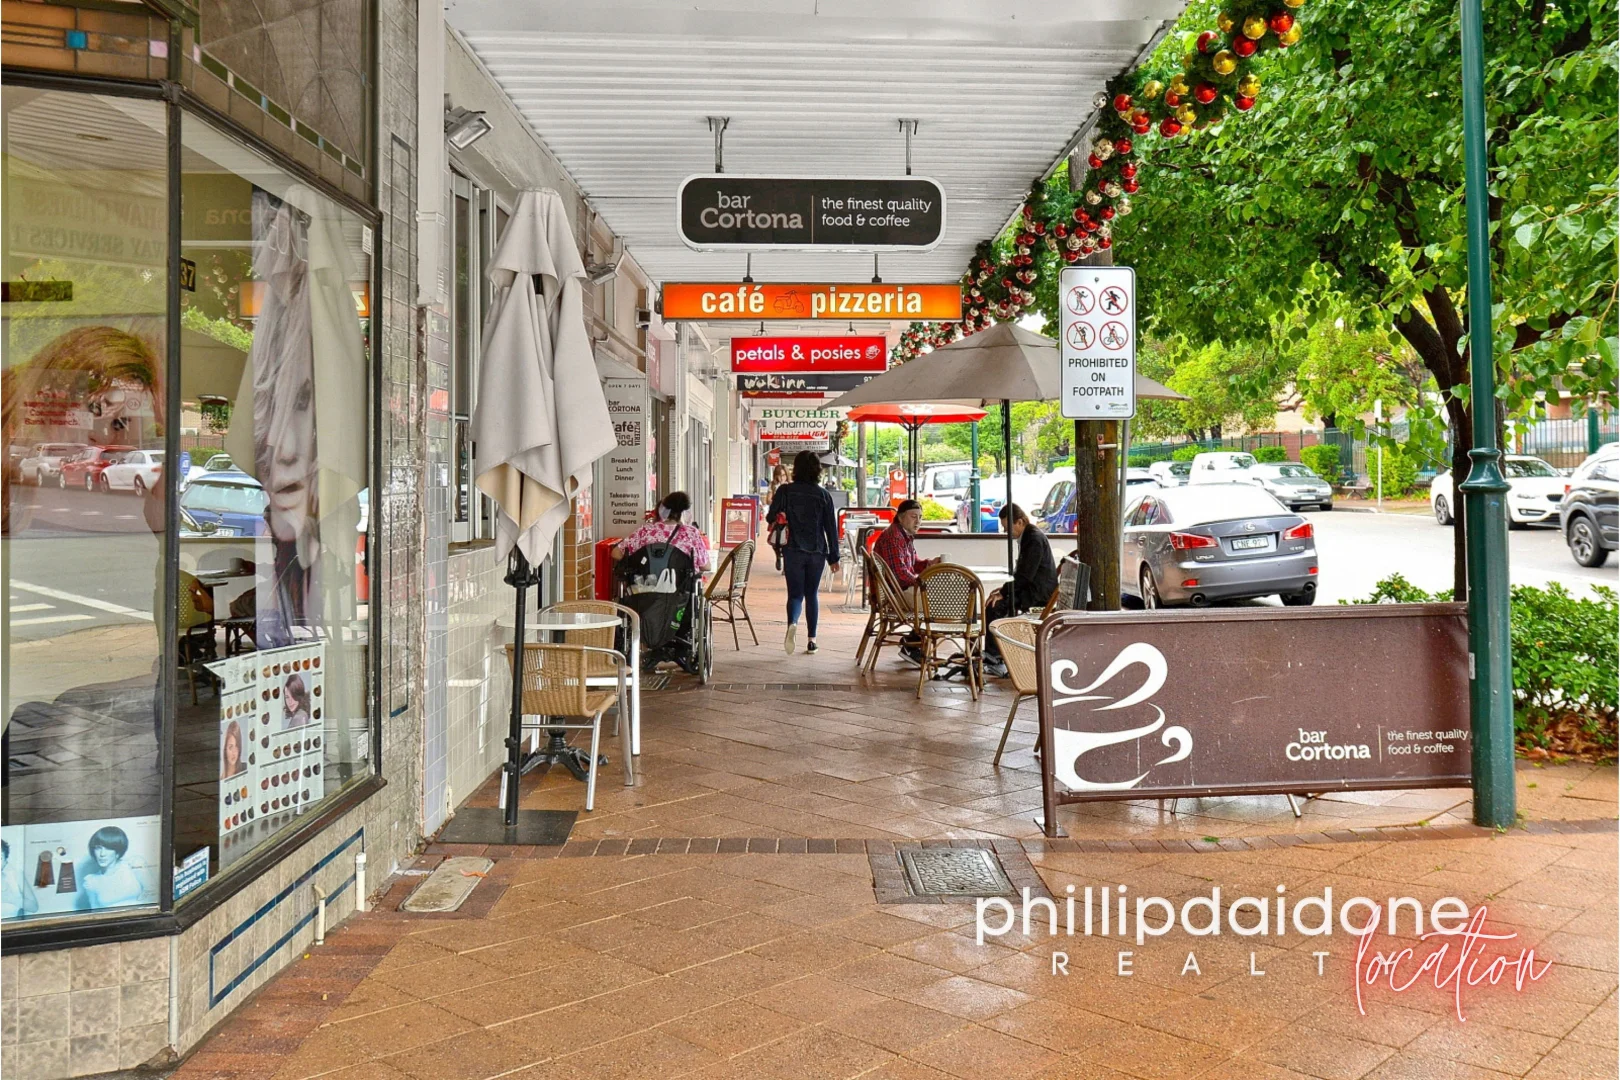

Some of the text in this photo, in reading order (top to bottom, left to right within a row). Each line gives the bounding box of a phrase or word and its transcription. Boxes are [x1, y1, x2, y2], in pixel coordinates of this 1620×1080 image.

[717, 191, 751, 209] bar
[822, 197, 932, 213] the finest quality
[700, 207, 804, 229] Cortona
[821, 213, 911, 227] food & coffee
[701, 286, 922, 319] café pizzeria
[736, 344, 862, 364] petals & posies
[1068, 358, 1128, 368] PROHIBITED
[1091, 372, 1105, 382] ON
[1073, 387, 1124, 396] FOOTPATH
[762, 409, 840, 418] BUTCHER
[612, 421, 634, 432] afé
[775, 420, 828, 430] pharmacy
[1298, 728, 1327, 744] bar
[1387, 729, 1469, 741] the finest quality
[1285, 742, 1371, 761] Cortona
[1387, 744, 1455, 755] food & coffee
